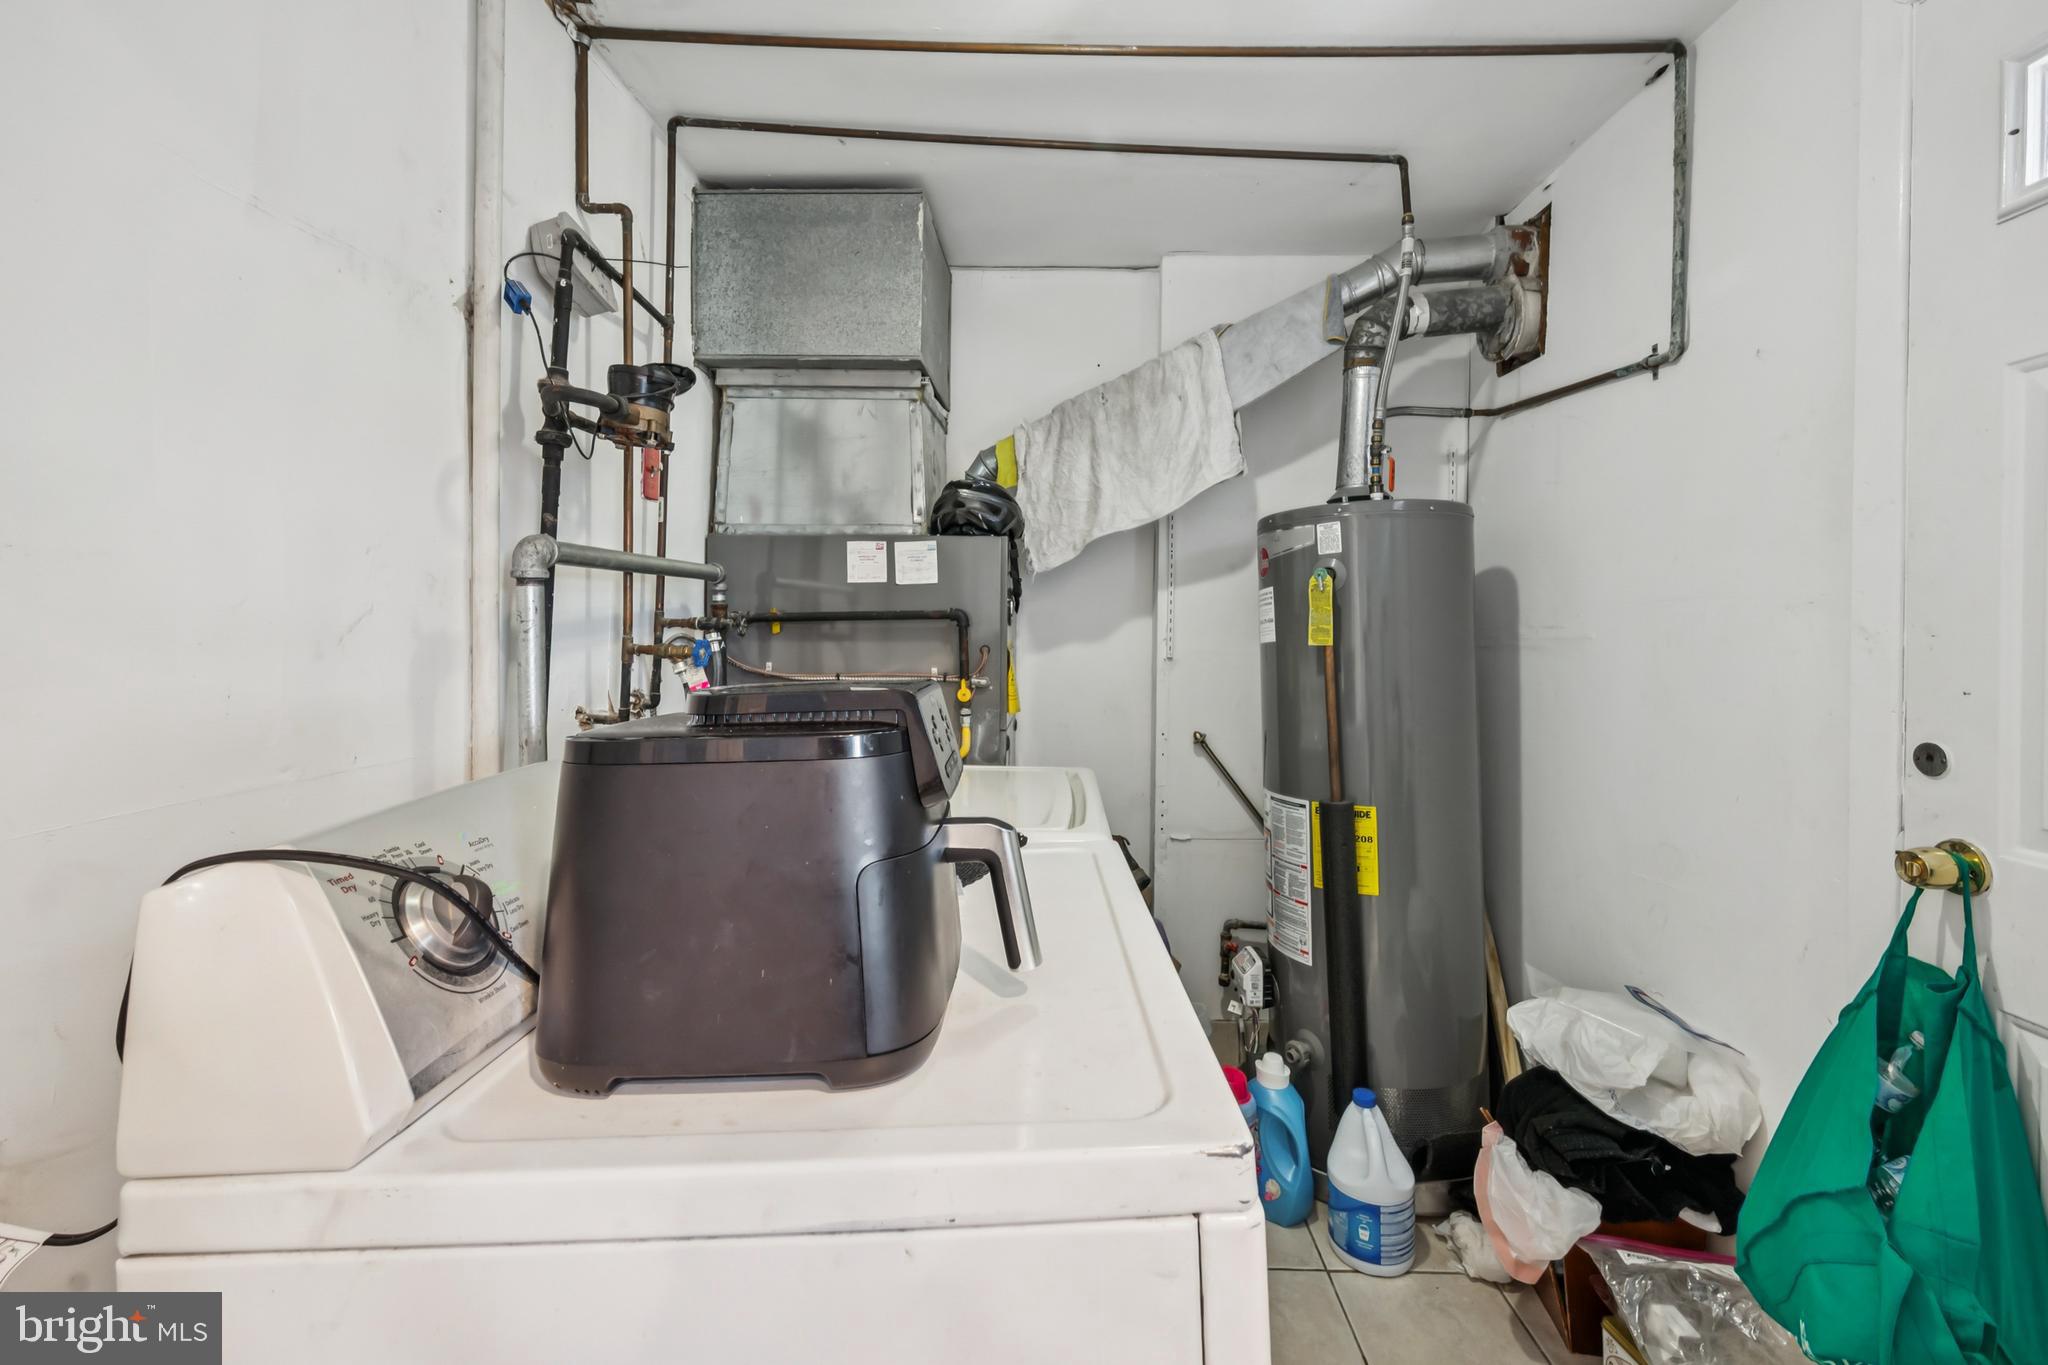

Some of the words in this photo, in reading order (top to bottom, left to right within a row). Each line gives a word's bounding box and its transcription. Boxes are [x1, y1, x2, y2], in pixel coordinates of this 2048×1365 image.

[326, 872, 355, 887] Timed
[340, 883, 358, 895] Dry
[361, 911, 380, 922] Heavy
[370, 919, 382, 928] Dry
